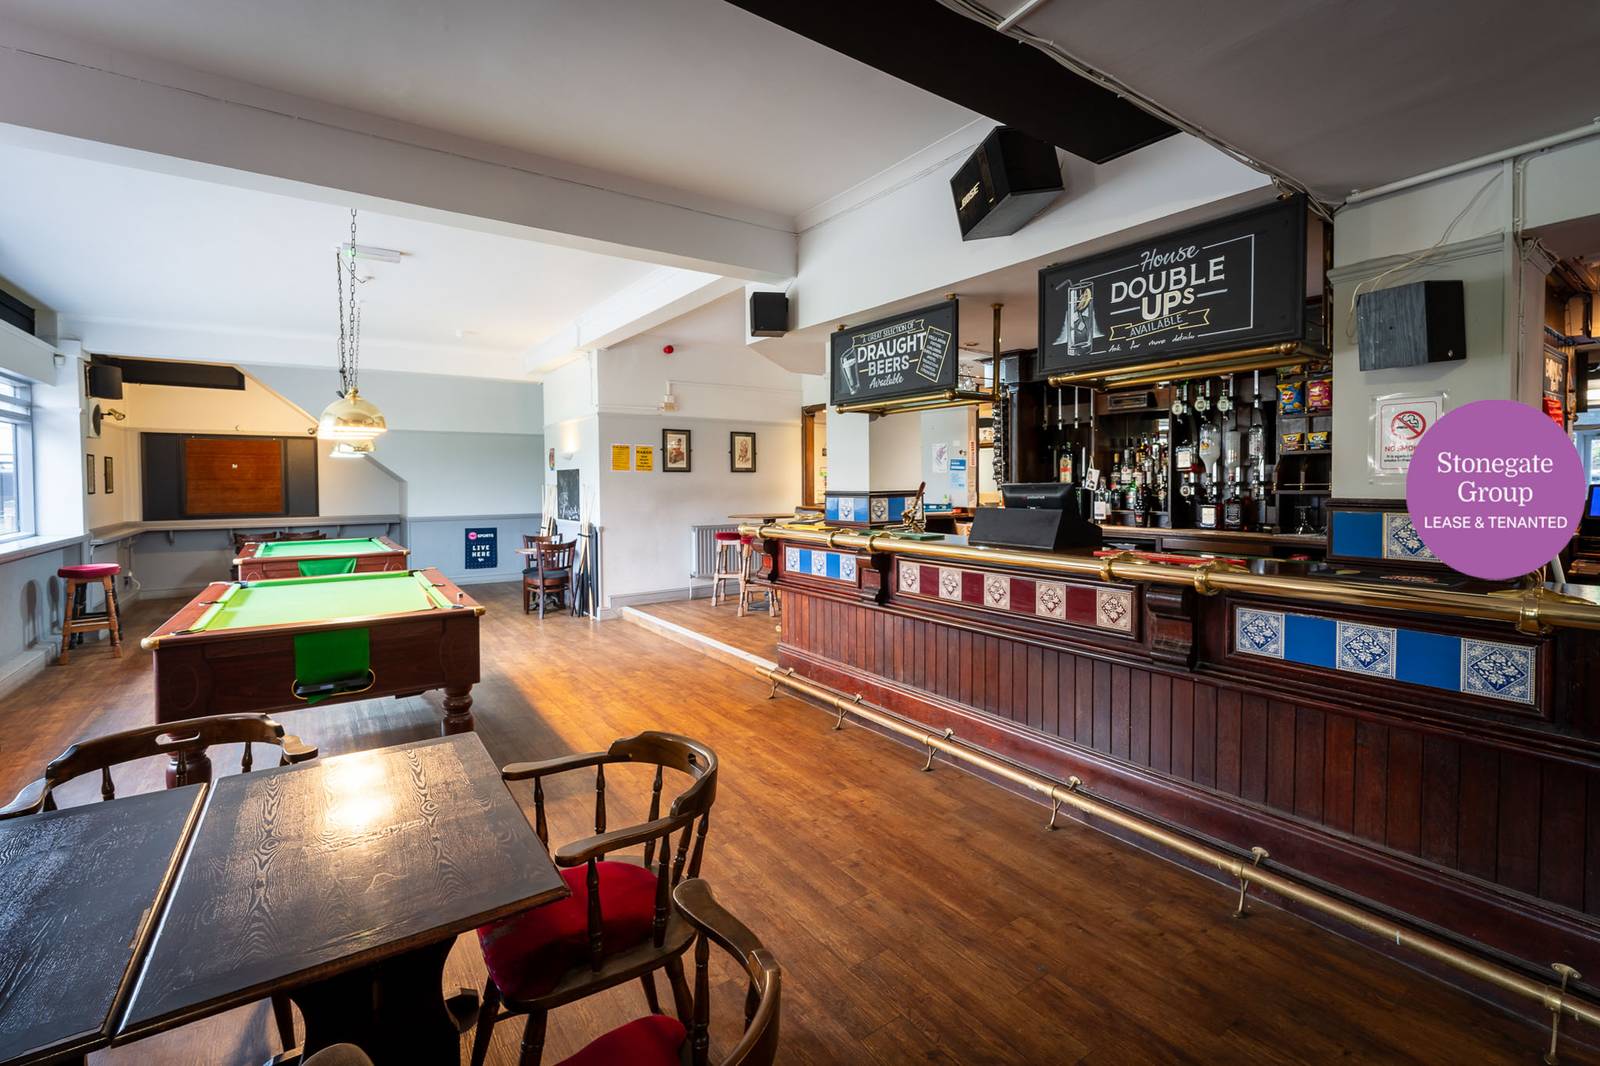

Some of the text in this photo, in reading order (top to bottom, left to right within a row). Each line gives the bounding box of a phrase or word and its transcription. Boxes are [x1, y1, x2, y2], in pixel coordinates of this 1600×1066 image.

[1140, 245, 1200, 272] House
[1110, 255, 1225, 304] DOUBLE
[882, 324, 908, 338] SELECTION
[1129, 313, 1184, 337] AVAILABLE
[857, 332, 926, 364] DRAUGHT
[868, 355, 910, 376] BEERS
[868, 373, 904, 389] Available
